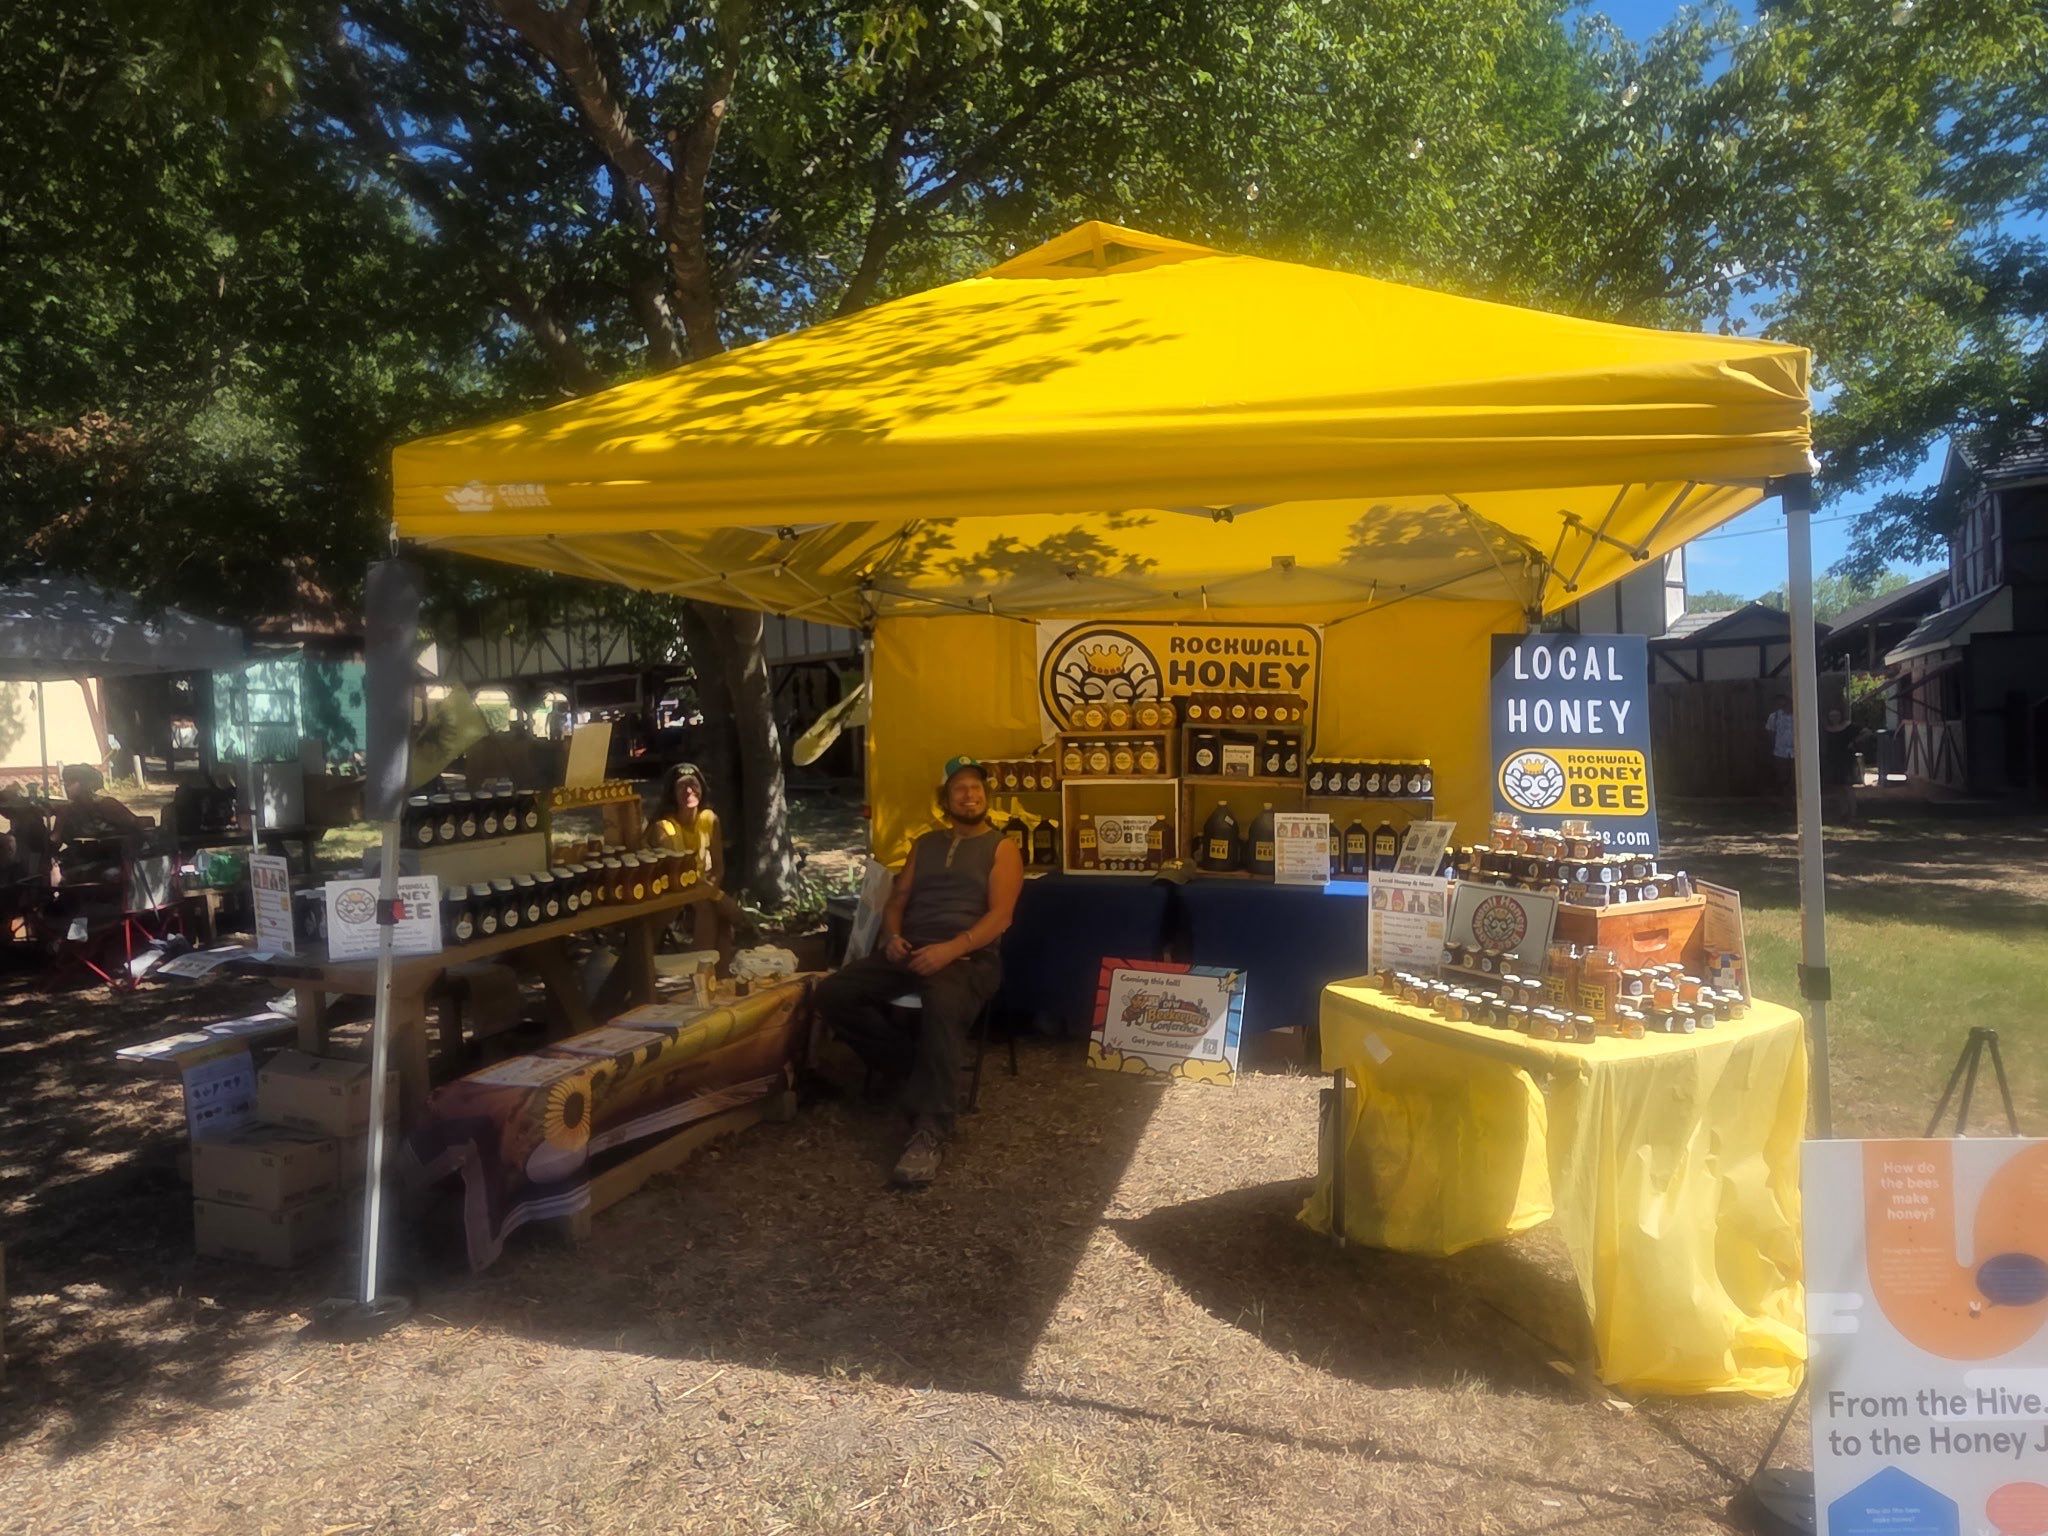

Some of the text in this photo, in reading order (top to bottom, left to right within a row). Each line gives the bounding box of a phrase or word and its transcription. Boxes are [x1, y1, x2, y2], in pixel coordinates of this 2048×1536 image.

[1170, 637, 1310, 656] ROCKWALL
[1514, 645, 1624, 681] LOCAL
[1169, 660, 1310, 689] HONEY
[1507, 698, 1631, 735] HONEY
[1567, 754, 1642, 765] ROCKWALL
[1567, 766, 1642, 780] HONEY
[1570, 783, 1645, 809] BEE
[403, 902, 432, 920] EE
[1120, 974, 1149, 985] Coming
[1150, 976, 1164, 985] this
[1147, 1008, 1208, 1027] Beekeepers
[1151, 1020, 1200, 1033] Conference
[1131, 1036, 1145, 1045] Get
[1146, 1038, 1165, 1048] your
[1883, 1161, 1936, 1173] How do
[1881, 1177, 1940, 1190] the bees
[1892, 1193, 1929, 1205] make
[1887, 1207, 1936, 1222] honey?
[1828, 1391, 1908, 1418] From
[1916, 1388, 1967, 1416] the
[1828, 1429, 1862, 1456] to
[1869, 1428, 1921, 1456] the
[1930, 1426, 2027, 1460] Honey
